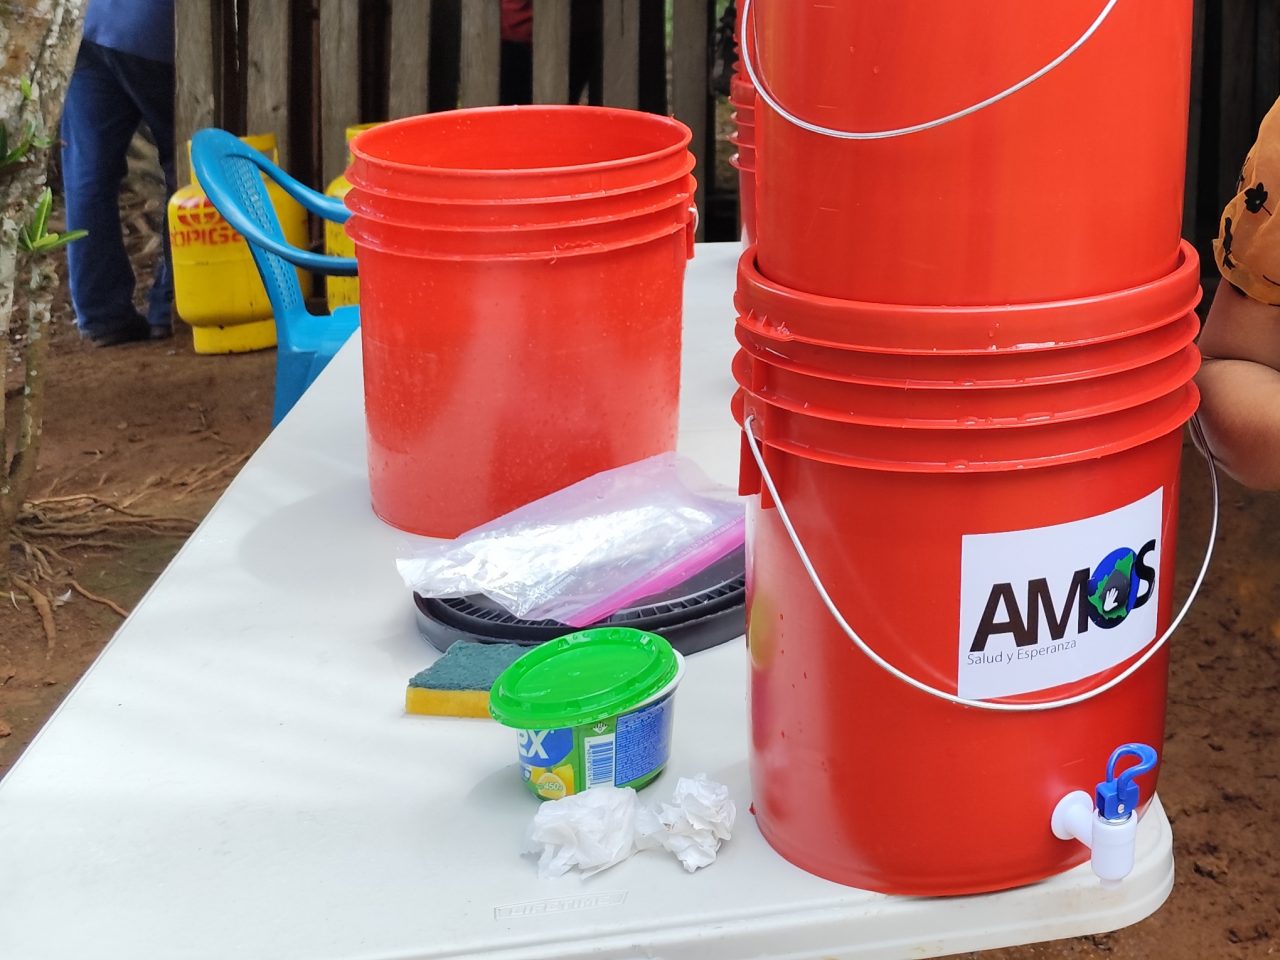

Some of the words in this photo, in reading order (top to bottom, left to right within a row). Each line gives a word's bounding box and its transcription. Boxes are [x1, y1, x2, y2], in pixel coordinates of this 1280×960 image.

[969, 539, 1156, 653] AMOS
[967, 651, 1003, 666] Salud
[1006, 654, 1014, 664] y
[1017, 640, 1077, 661] Esperanza
